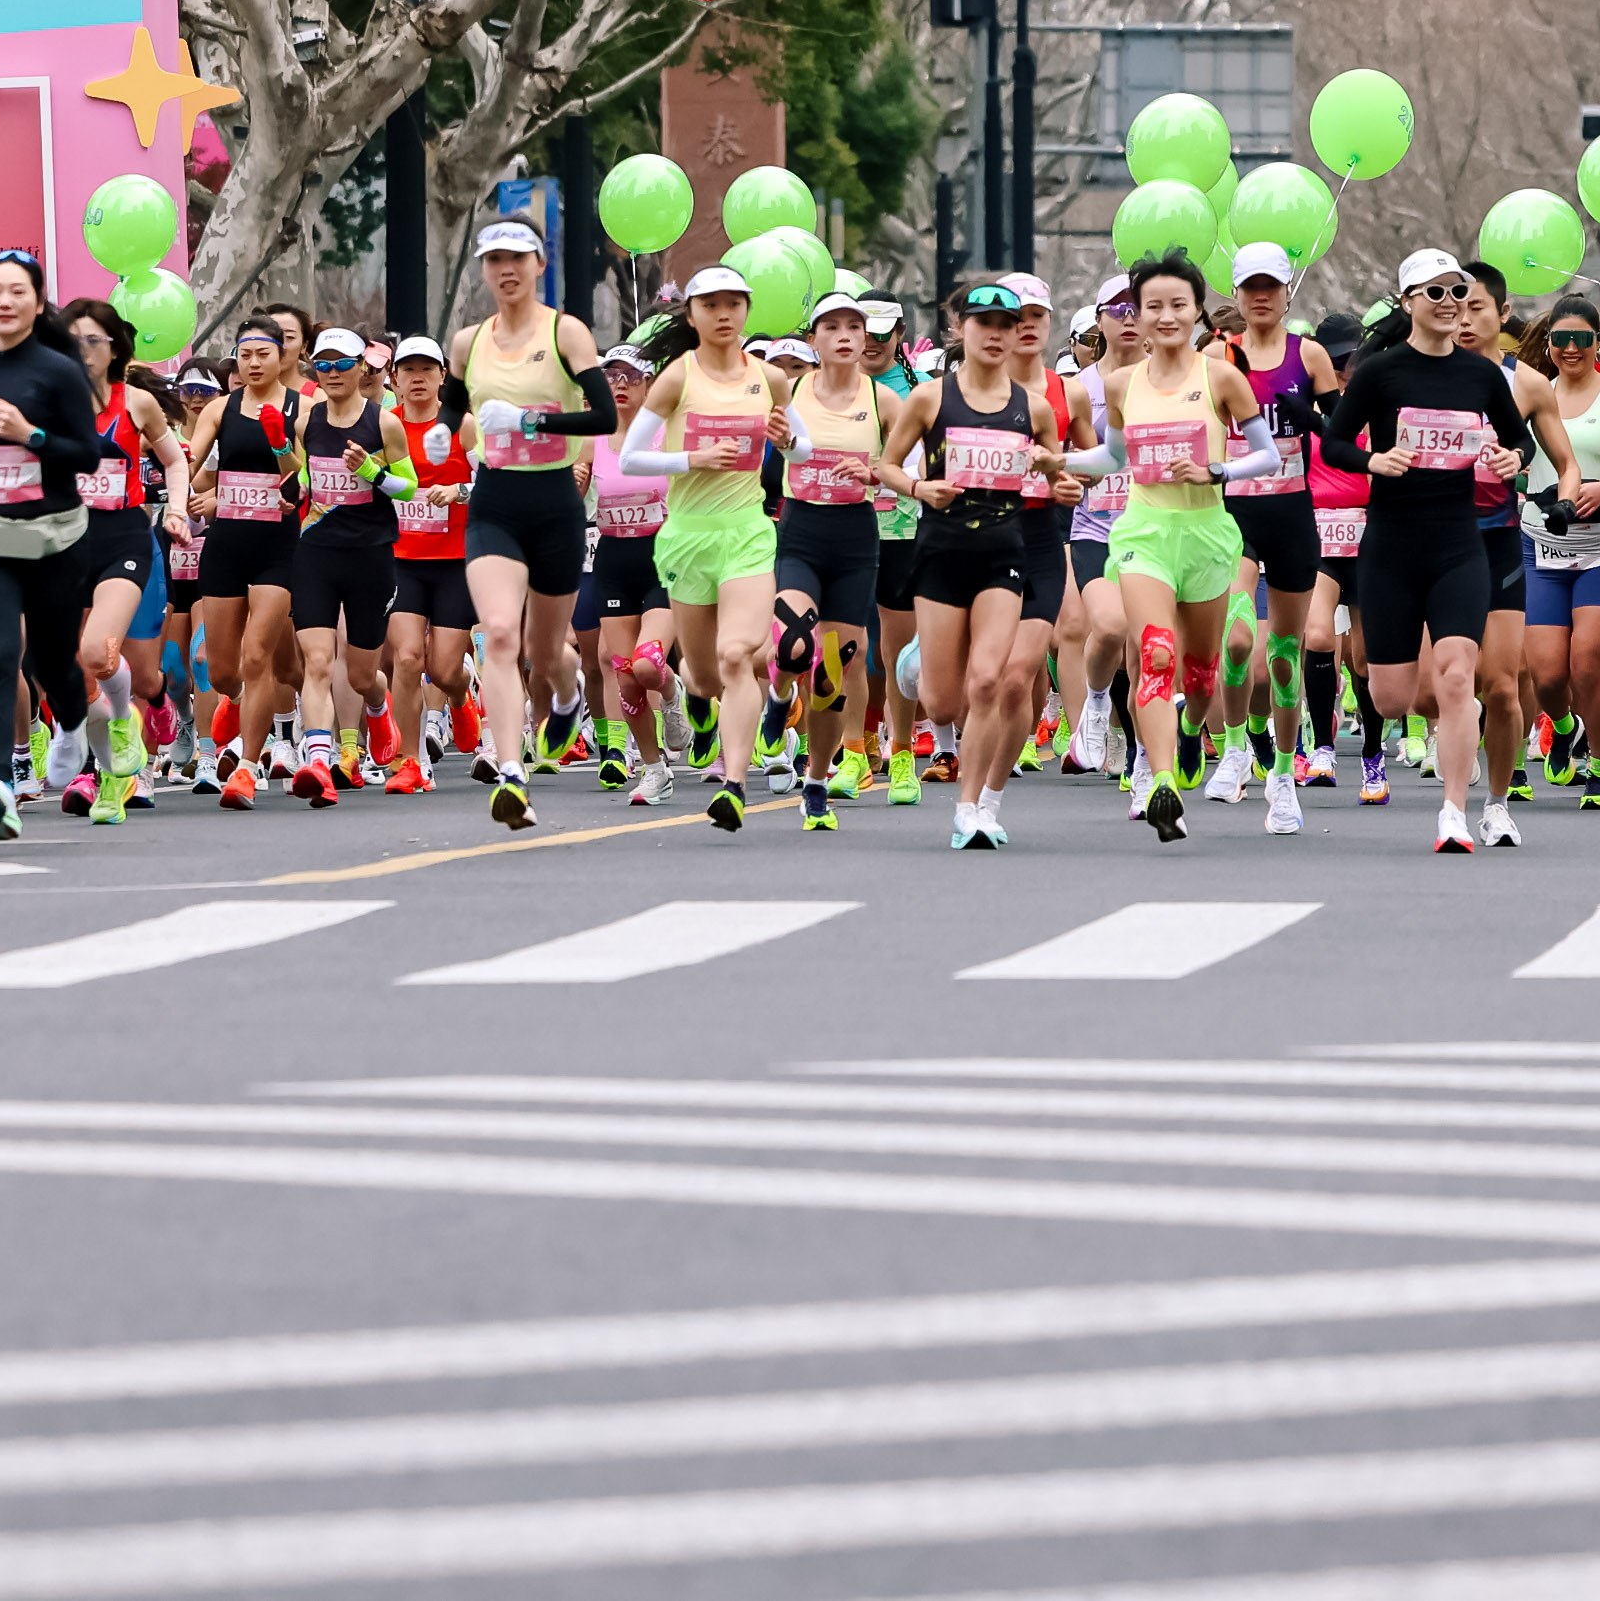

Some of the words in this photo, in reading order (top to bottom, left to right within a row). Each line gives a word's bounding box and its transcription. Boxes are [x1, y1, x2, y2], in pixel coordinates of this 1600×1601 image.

[1400, 429, 1409, 444] A
[1415, 429, 1464, 452] 1354
[949, 447, 958, 462] A
[965, 448, 1014, 472] 1003
[320, 472, 359, 491] 2125
[230, 488, 269, 506] 1033
[399, 502, 434, 519] 1081
[607, 506, 648, 525] 1122
